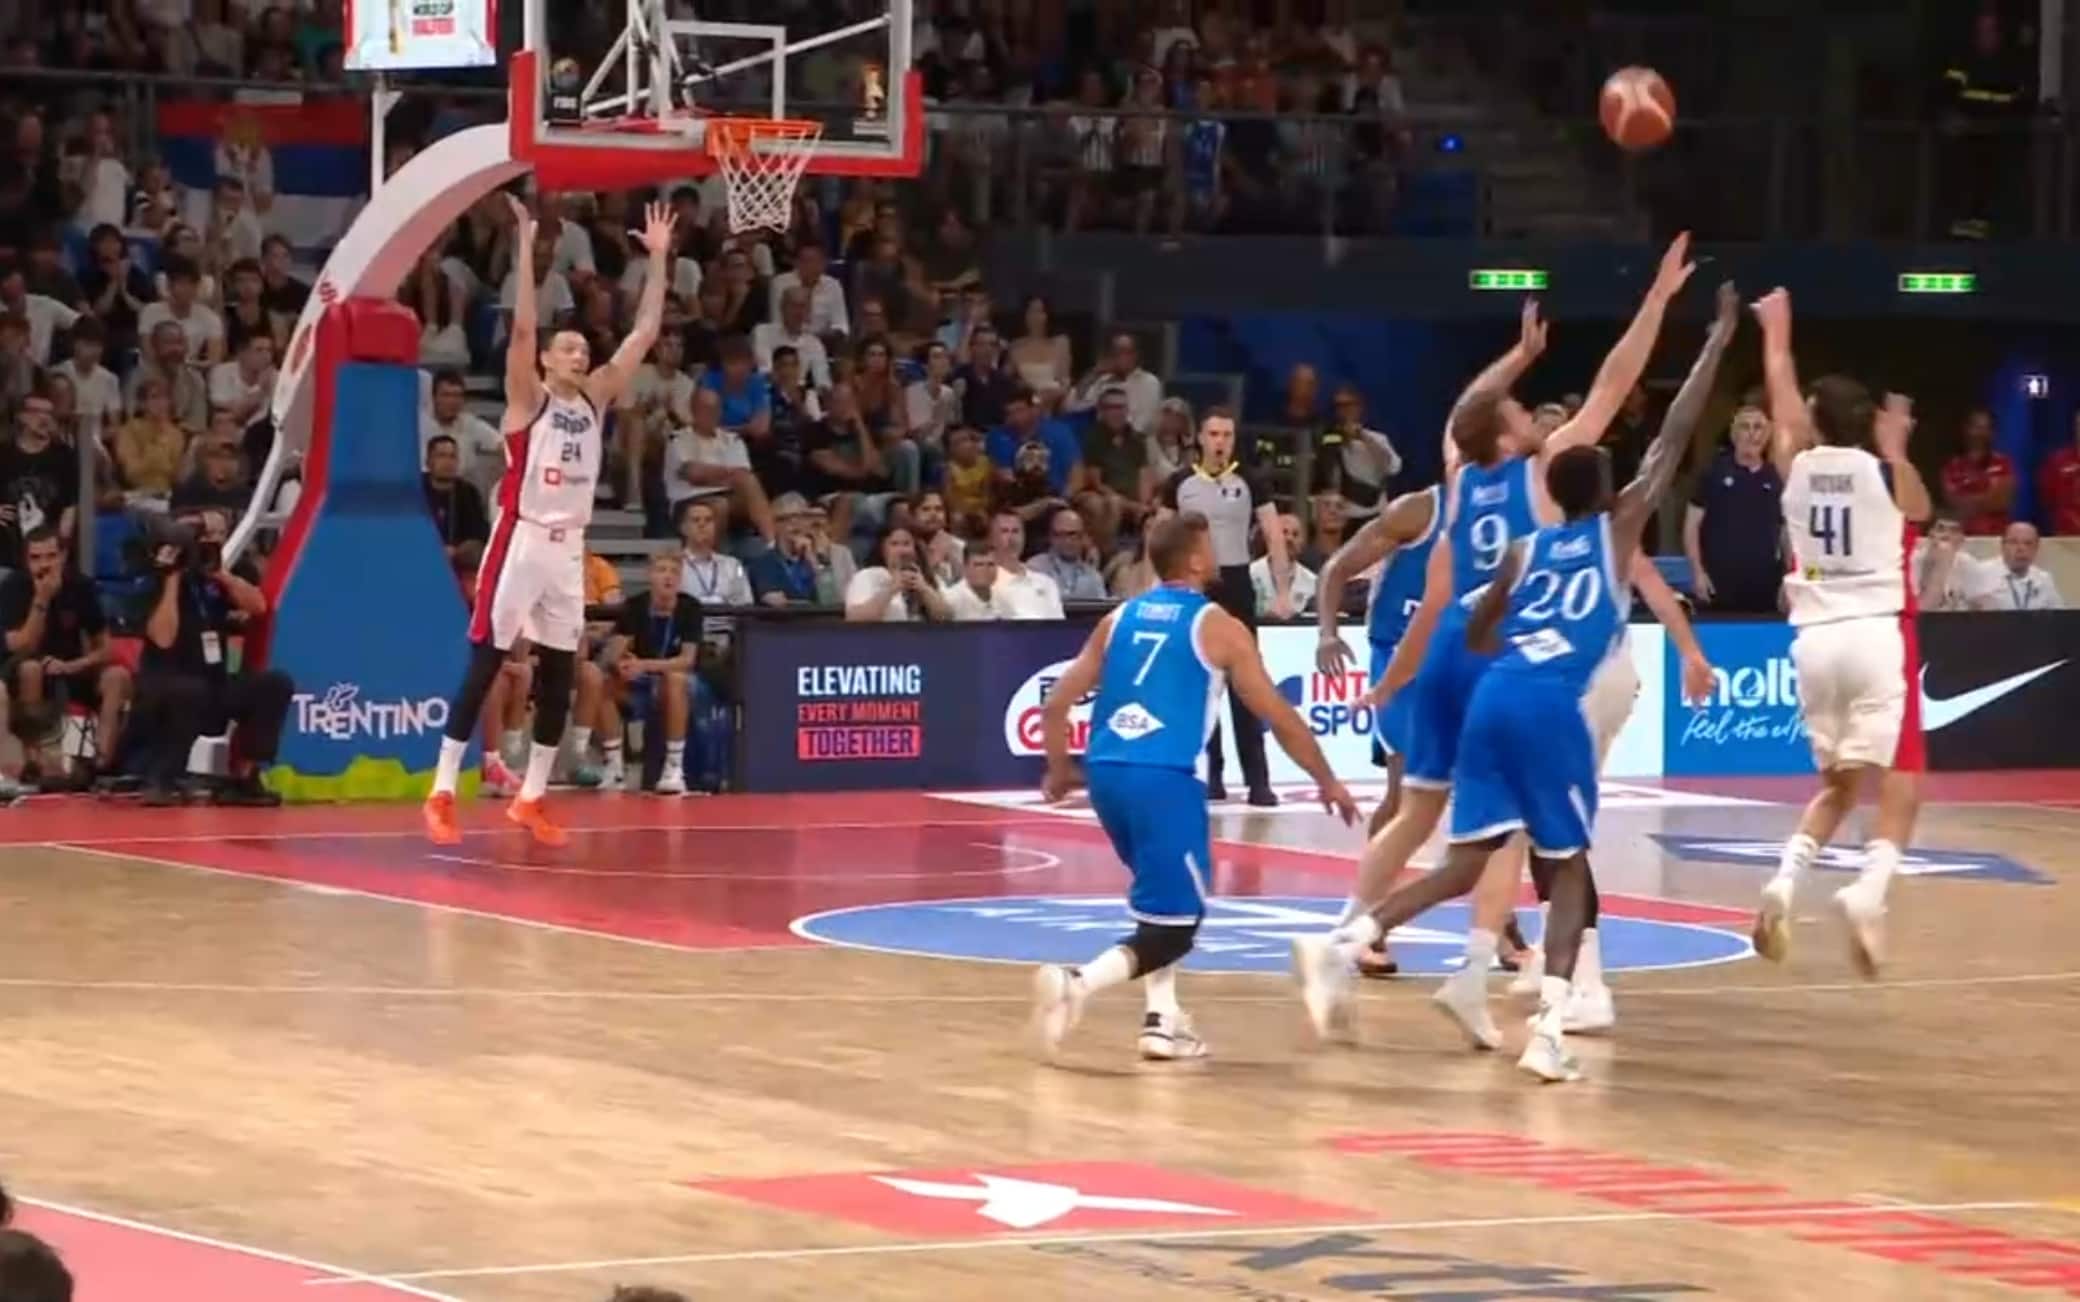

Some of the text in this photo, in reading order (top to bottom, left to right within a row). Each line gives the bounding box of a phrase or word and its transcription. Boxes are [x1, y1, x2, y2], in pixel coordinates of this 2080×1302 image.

[1470, 514, 1509, 571] 9
[1808, 505, 1852, 557] 41
[1518, 566, 1601, 621] 20
[798, 664, 922, 696] ELEVATING
[1133, 631, 1169, 686] 7
[292, 693, 449, 740] TRENTINO
[798, 700, 920, 722] EVERY MOMENT
[804, 729, 914, 757] TOGETHER
